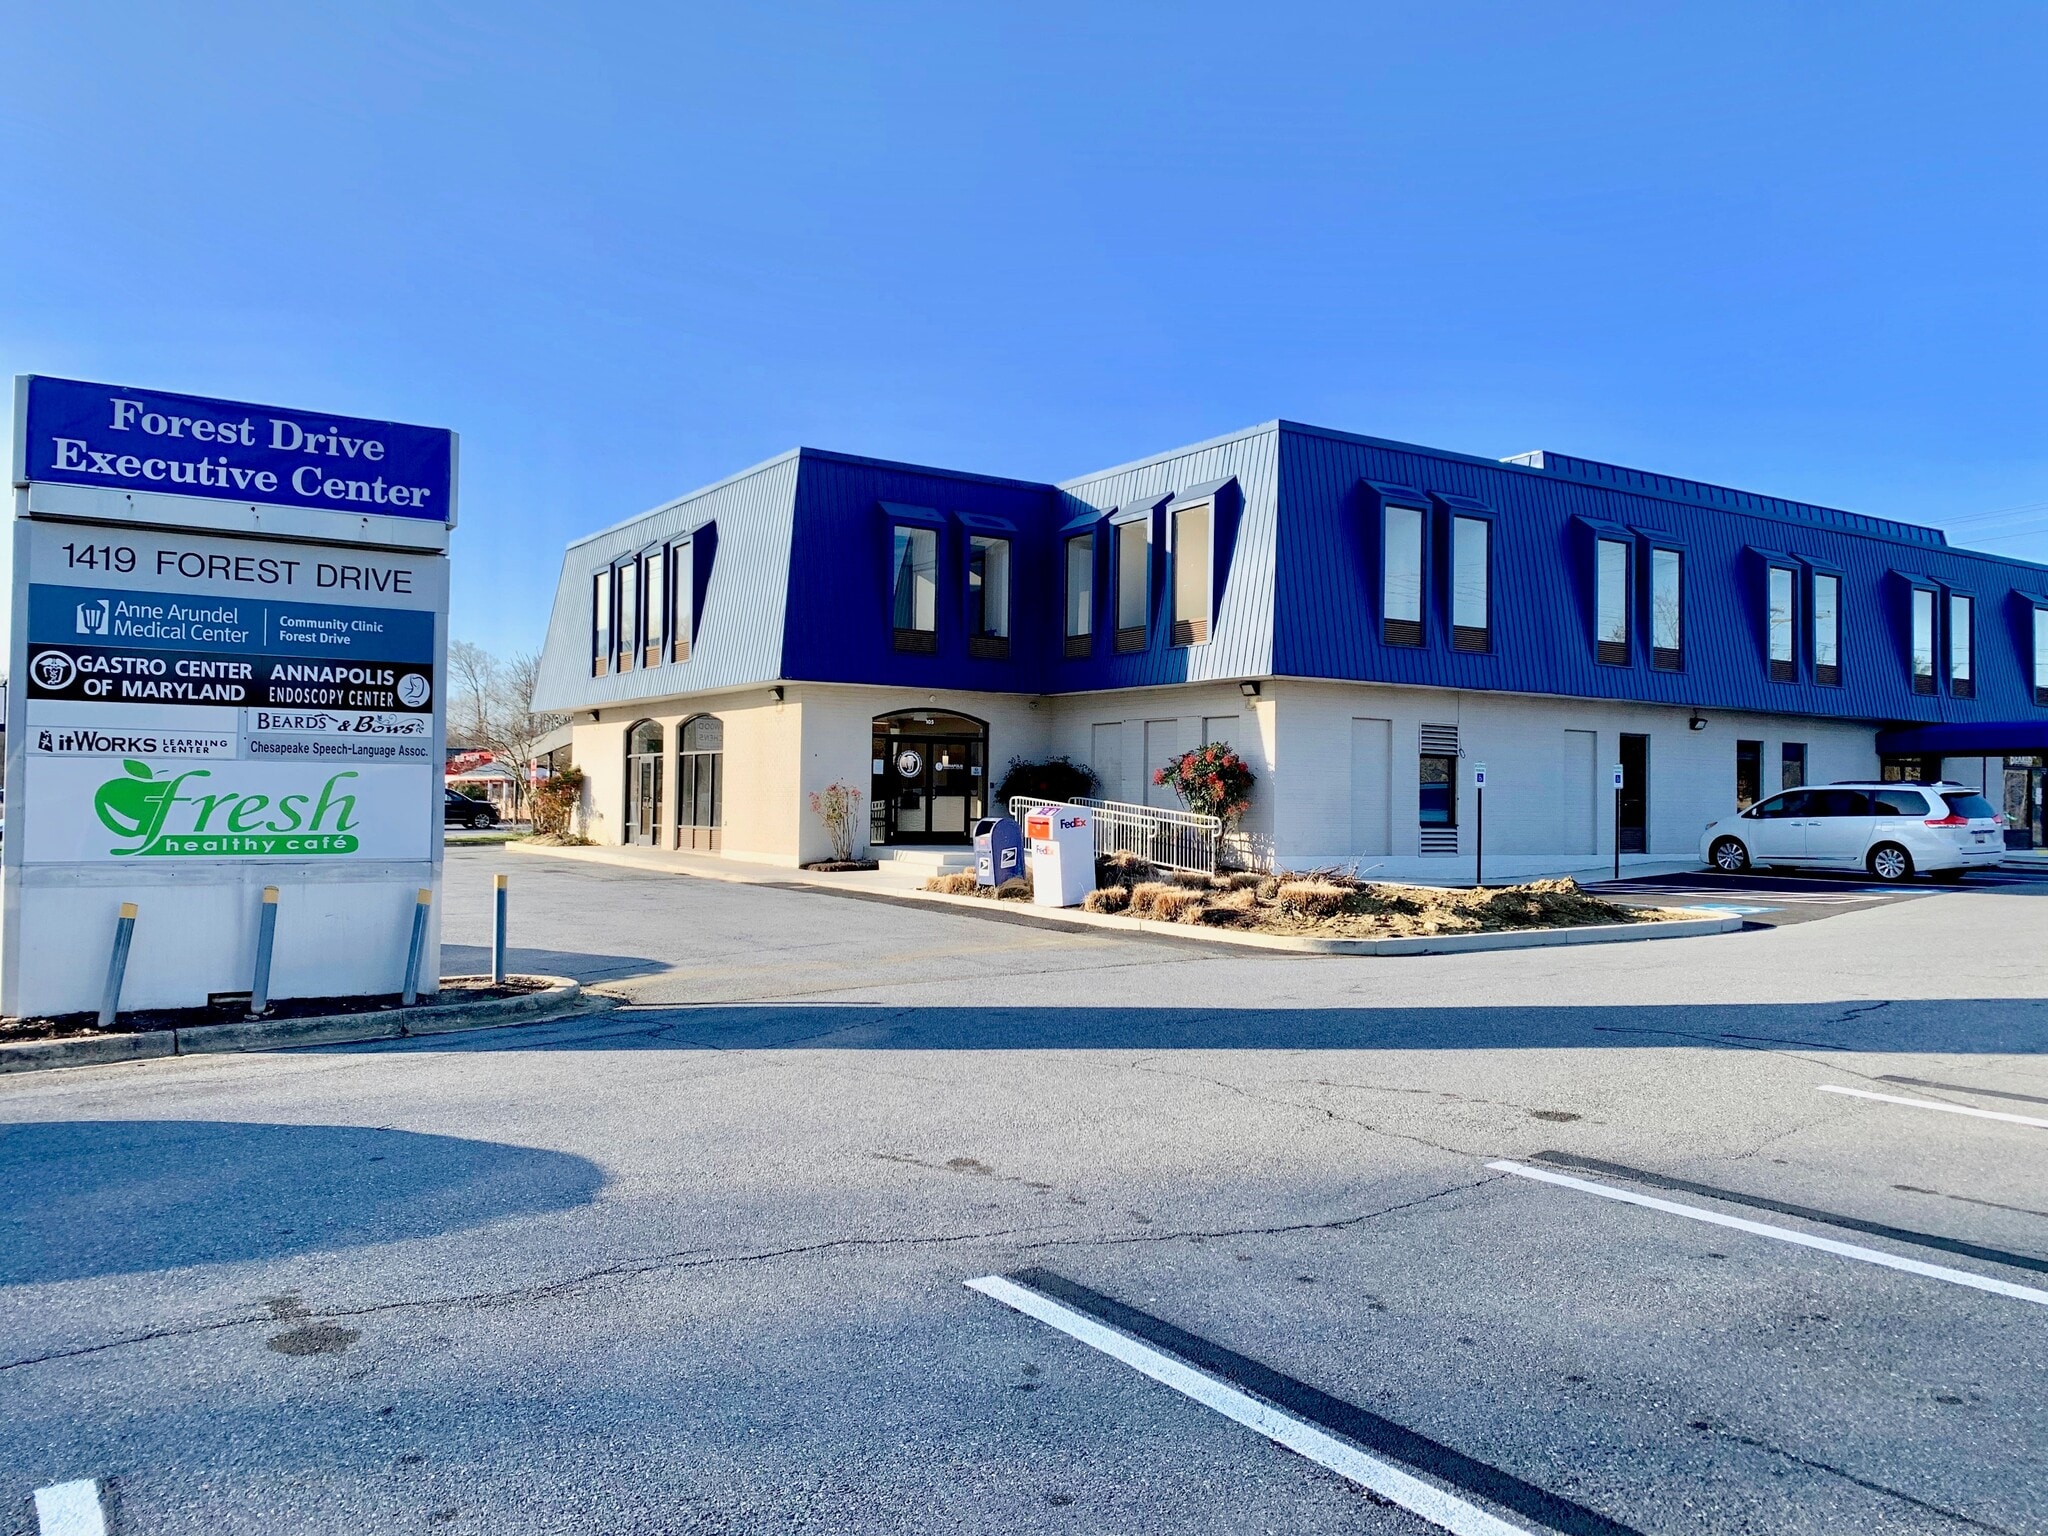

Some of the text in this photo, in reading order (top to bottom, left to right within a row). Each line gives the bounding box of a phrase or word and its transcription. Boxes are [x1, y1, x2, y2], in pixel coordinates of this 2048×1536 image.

[109, 398, 385, 461] Forest Drive
[51, 437, 430, 508] Executive Center
[62, 543, 413, 594] 1419 FOREST DRIVE
[114, 600, 239, 624] Anne Arundel
[114, 619, 249, 643] Medical Center
[279, 615, 384, 633] Community Clinic
[279, 630, 351, 645] Forest Drive
[77, 655, 253, 680] GASTRO CENTER
[270, 664, 395, 686] ANNAPOLIS
[84, 678, 246, 701] OF MARYLAND
[269, 686, 394, 707] ENDOSCOPY CENTER
[257, 712, 416, 734] BEARDS & Bows
[58, 730, 157, 753] itWORKS
[162, 738, 228, 749] LEARNING
[162, 745, 210, 754] CENTER
[250, 740, 429, 758] Chesapeake Speech-Language Assoc.
[110, 769, 360, 856] fresh
[1060, 816, 1087, 830] FedEx
[165, 835, 347, 853] healthy café
